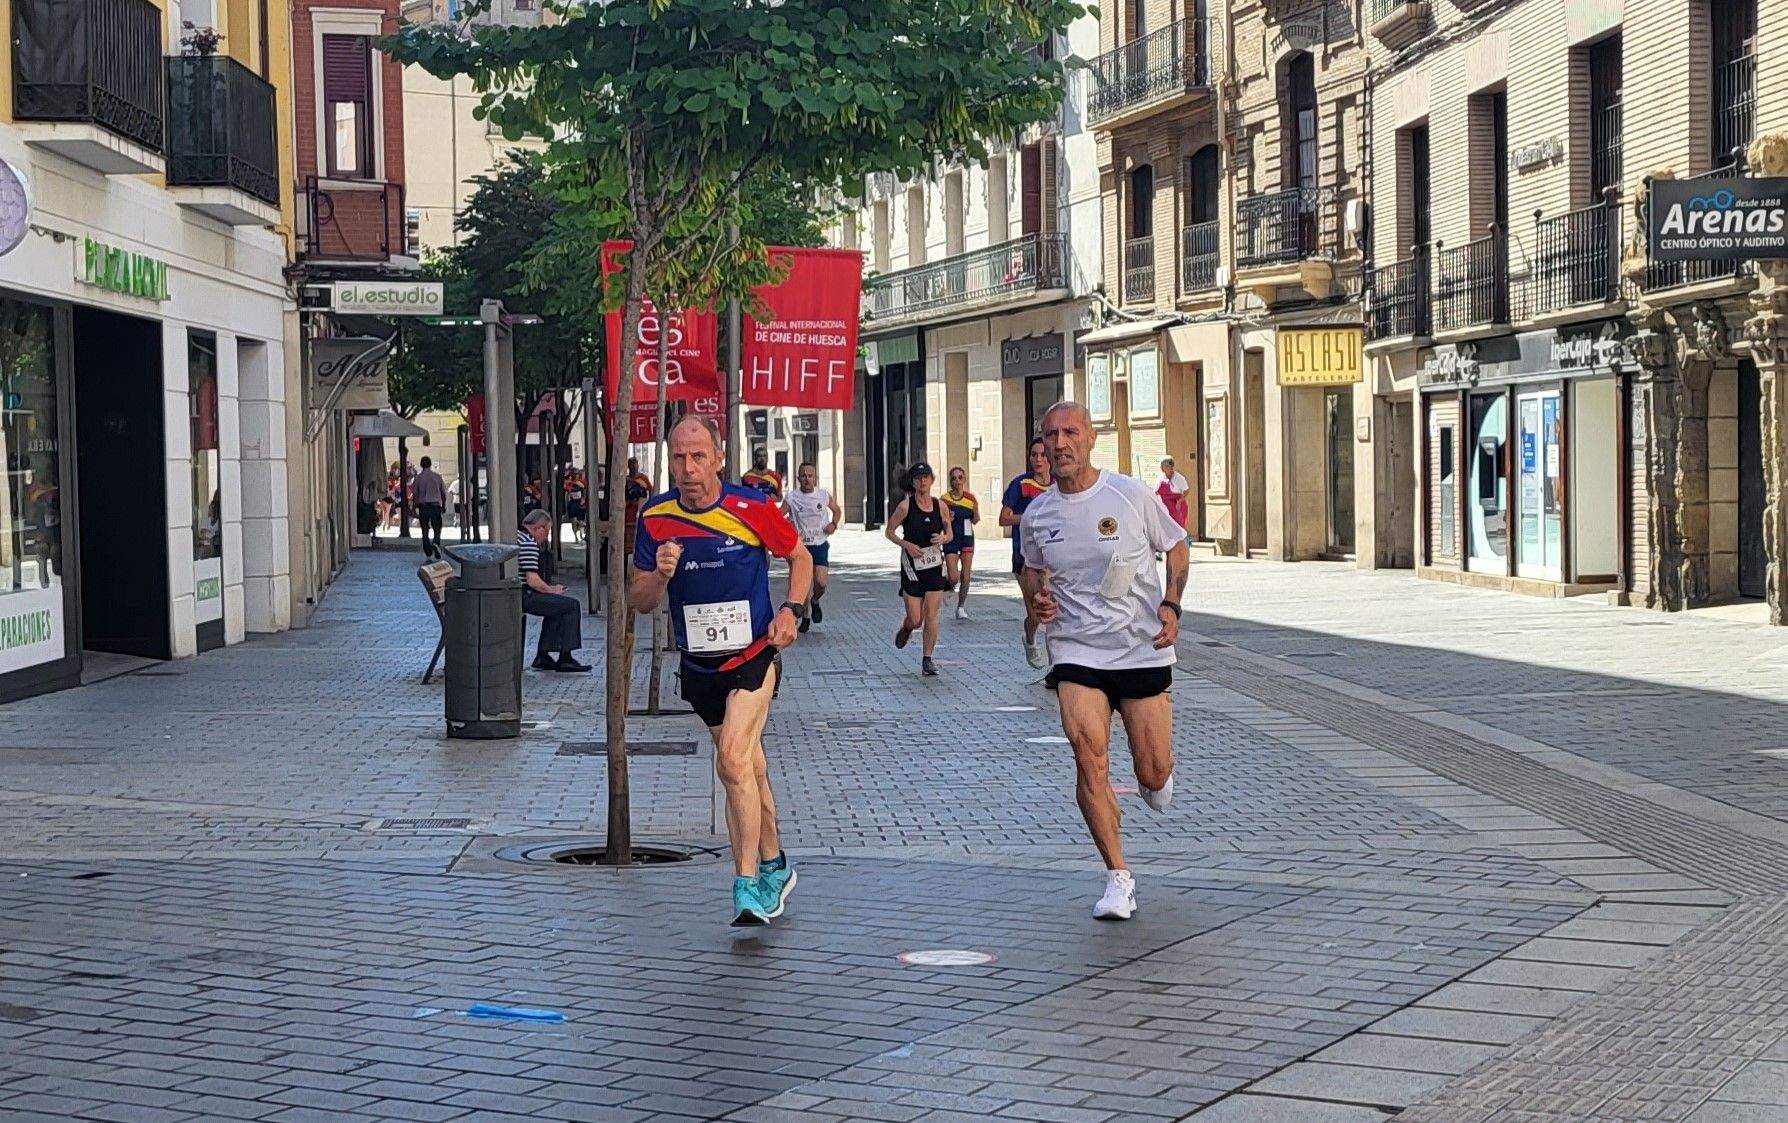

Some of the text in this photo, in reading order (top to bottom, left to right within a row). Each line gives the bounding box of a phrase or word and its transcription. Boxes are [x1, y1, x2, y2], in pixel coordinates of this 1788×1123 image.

[1735, 198, 1759, 208] desde
[1660, 203, 1785, 235] Arenas
[1660, 236, 1785, 250] CENTRO ÓPTICO Y AUDITIVO
[755, 320, 848, 330] FESTIVAL INTERNACIONAL
[755, 331, 847, 347] DE CINE DE HUESCA
[1283, 331, 1357, 373] ASCASO
[752, 355, 847, 394] HIFF
[694, 396, 720, 413] es
[0, 608, 51, 651] PARACIONES
[706, 626, 729, 642] 91
